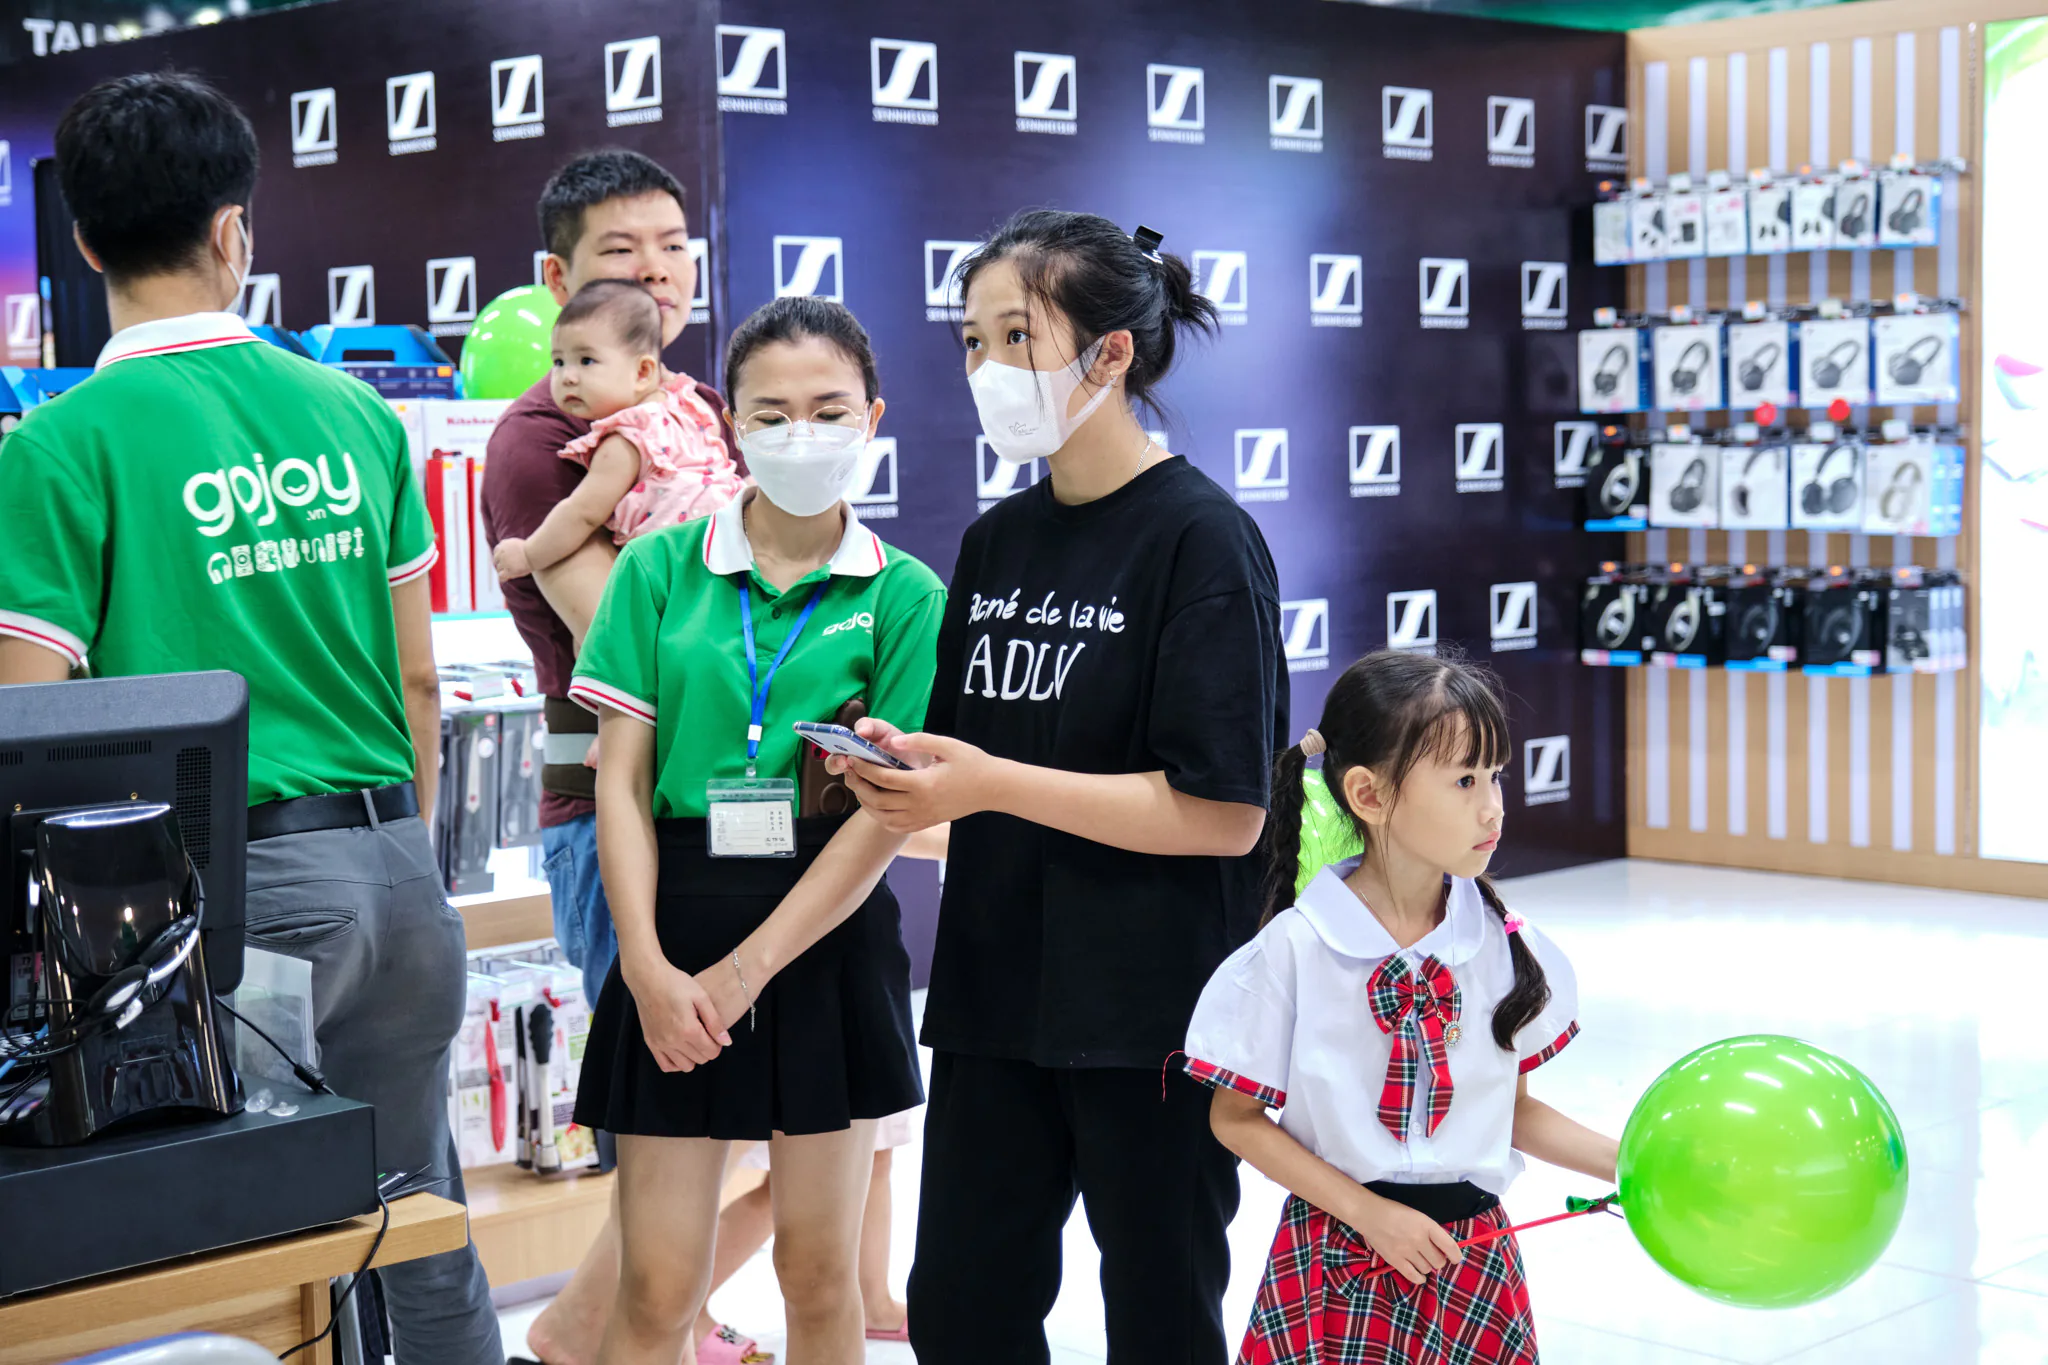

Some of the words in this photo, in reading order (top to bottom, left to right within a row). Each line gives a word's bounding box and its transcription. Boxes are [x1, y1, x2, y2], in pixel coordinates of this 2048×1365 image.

[717, 96, 787, 115] SENNHEISER
[872, 106, 939, 126] SENNHEISER
[1016, 117, 1077, 135] SENNHEISER
[182, 452, 361, 537] gojoy
[1025, 591, 1063, 625] de
[1069, 600, 1096, 629] la
[963, 633, 1086, 701] ADLV
